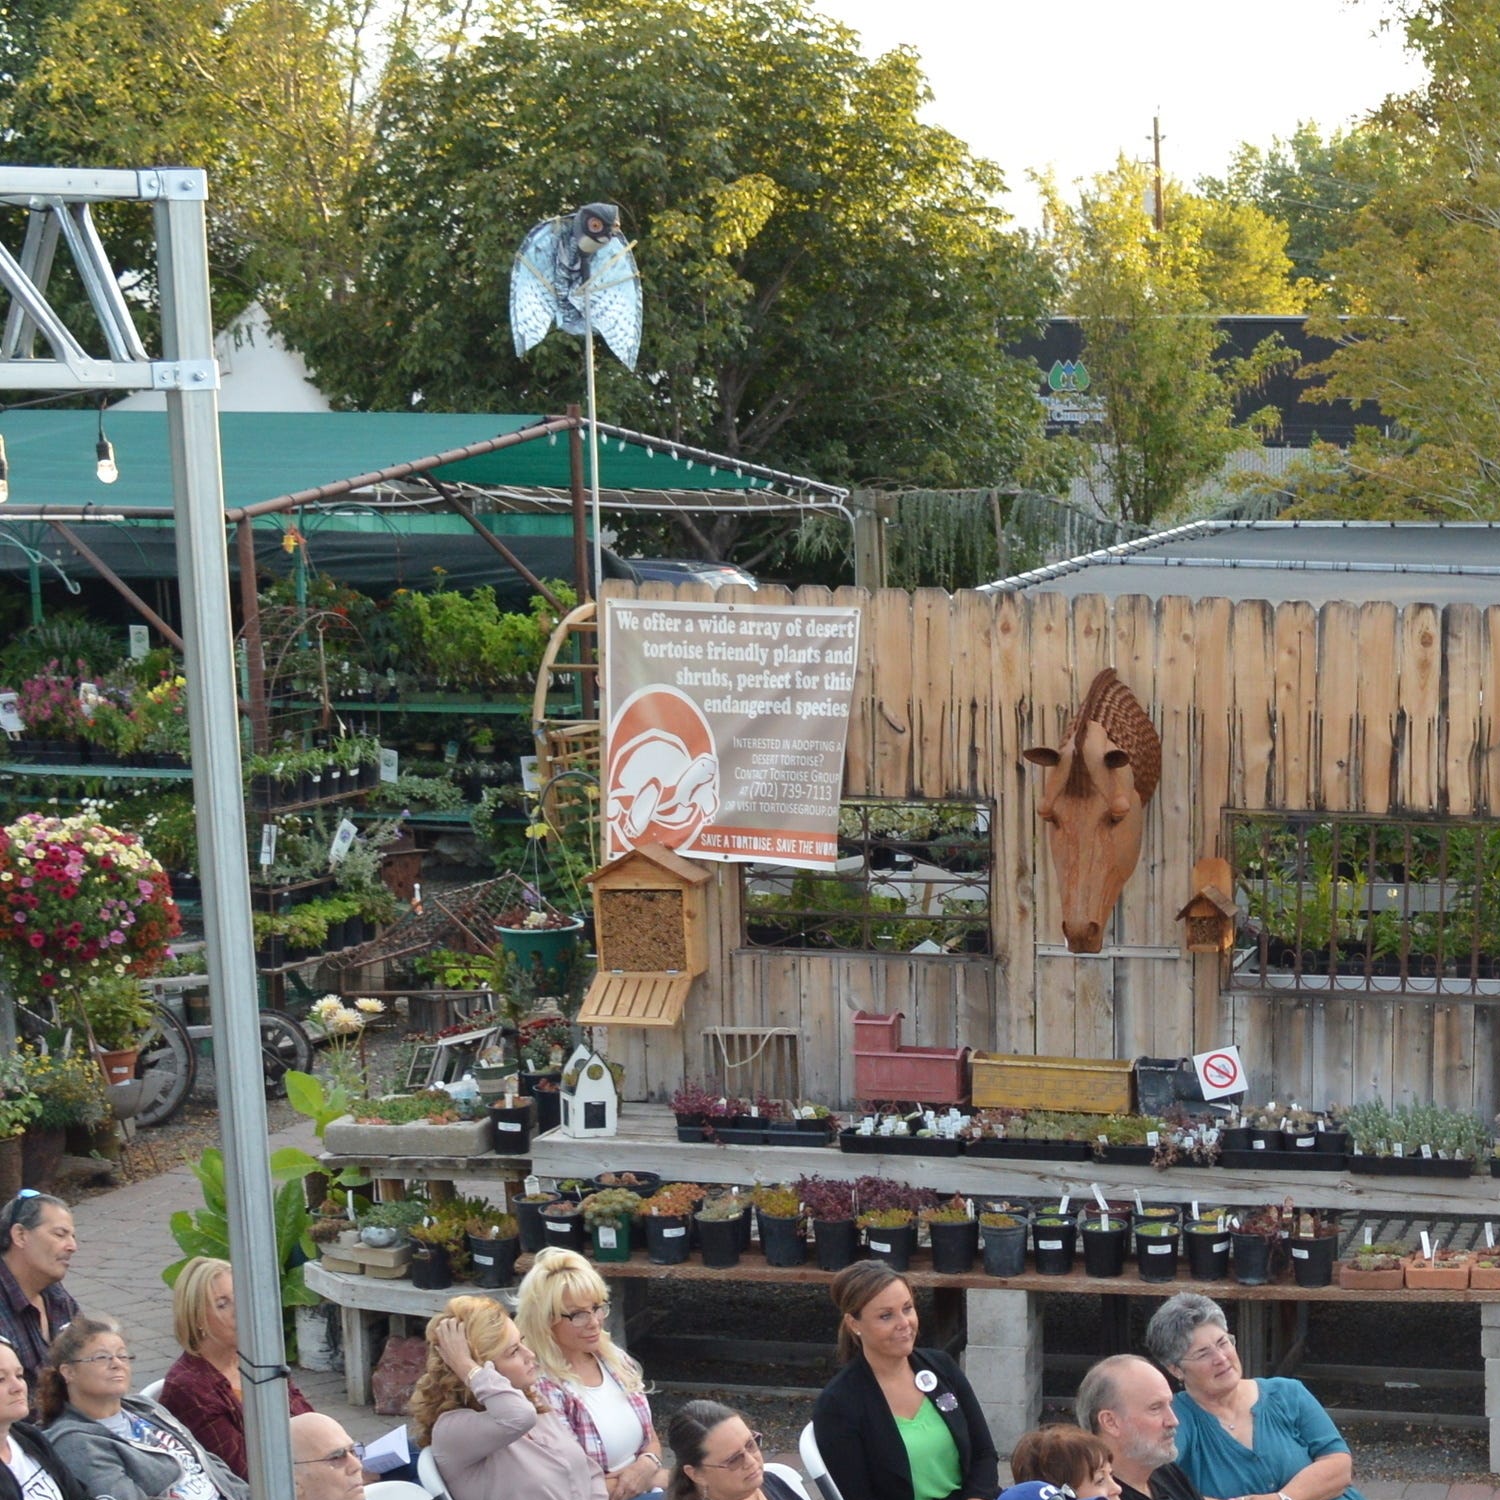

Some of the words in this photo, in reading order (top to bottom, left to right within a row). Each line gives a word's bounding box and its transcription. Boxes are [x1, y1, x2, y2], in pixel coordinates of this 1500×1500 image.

[616, 610, 640, 630] We
[643, 612, 682, 633] offer
[685, 618, 694, 633] a
[698, 614, 736, 634] wide
[739, 619, 782, 640] array
[785, 617, 803, 637] of
[805, 619, 855, 638] desert
[642, 640, 704, 659] tortoise
[706, 641, 769, 666] friendly
[773, 643, 821, 667] plants
[825, 646, 853, 665] and
[675, 666, 733, 691] shrubs,
[736, 669, 792, 692] perfect
[795, 670, 820, 689] for
[823, 671, 853, 691] this
[703, 694, 792, 719] endangered
[749, 781, 778, 800] (702)
[781, 783, 833, 801] 739-7113
[759, 801, 839, 817] TORTOISEGROUP.OR
[701, 833, 722, 848] SAVE
[723, 834, 730, 849] A
[776, 838, 797, 853] SAVE
[799, 839, 815, 855] THE
